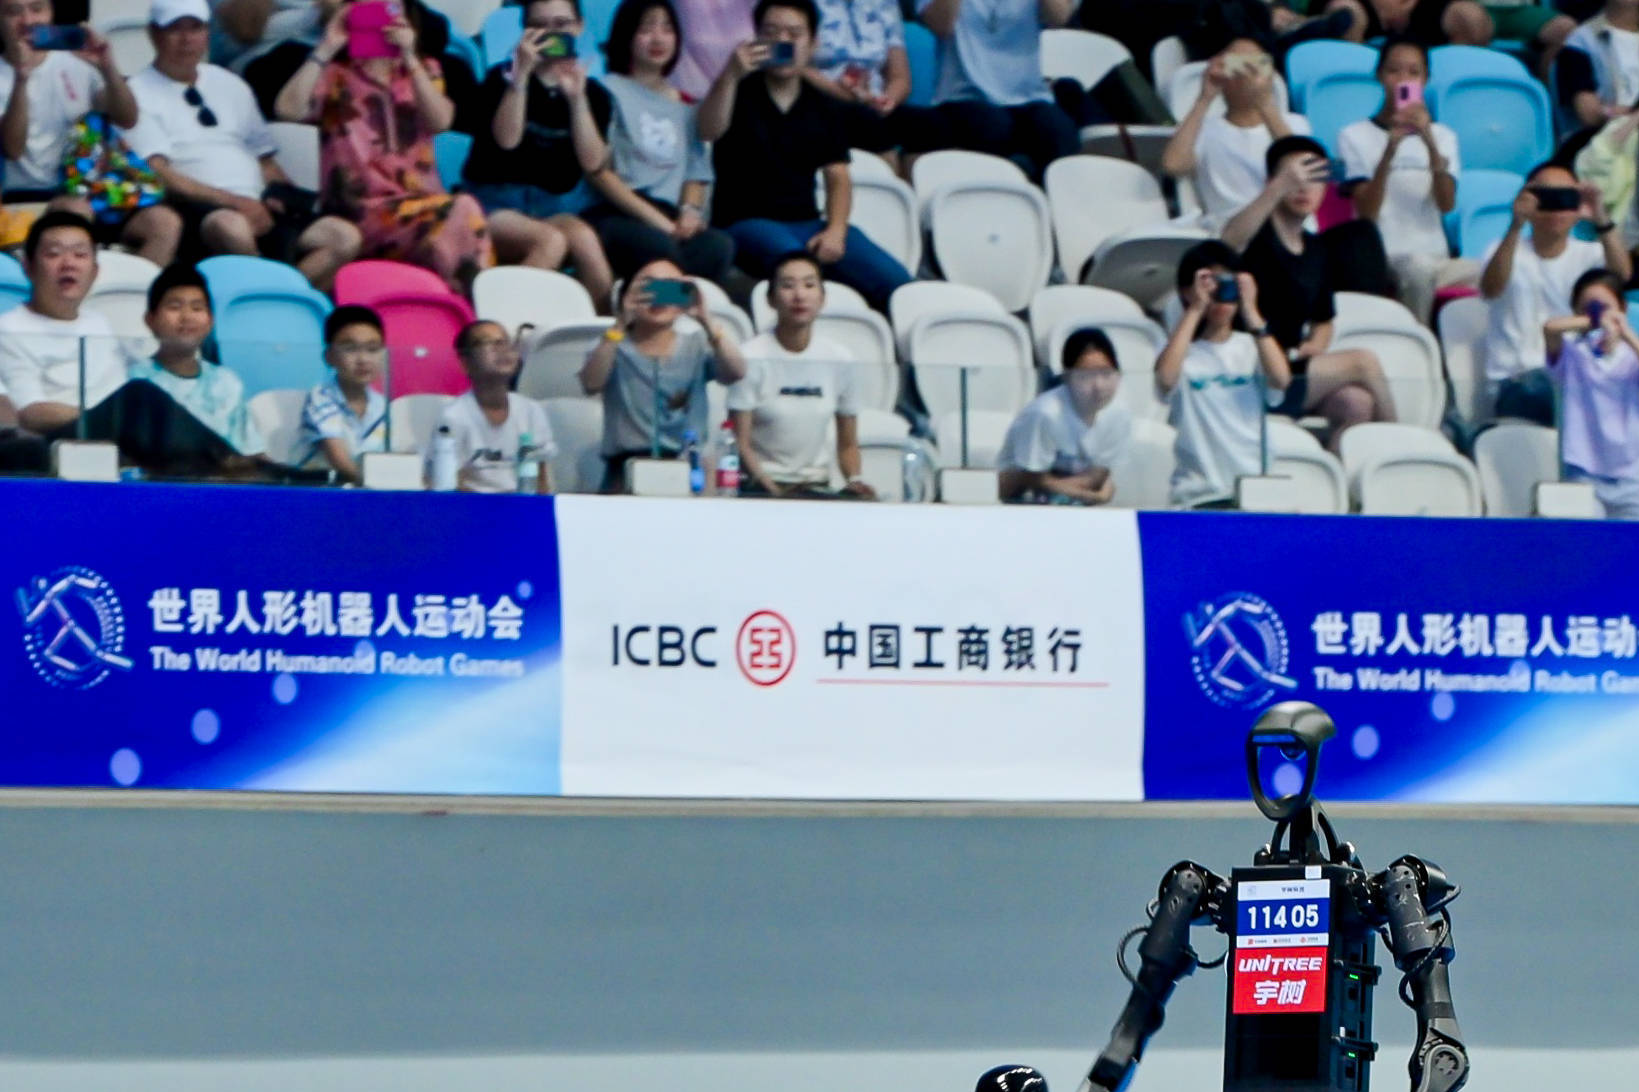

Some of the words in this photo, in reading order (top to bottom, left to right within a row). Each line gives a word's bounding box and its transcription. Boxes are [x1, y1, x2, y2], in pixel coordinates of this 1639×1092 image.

[149, 587, 524, 640] 世界人形机器人运动会
[149, 645, 191, 672] The
[195, 648, 262, 673] World
[265, 649, 376, 674] Humanoid
[380, 651, 446, 676] Robot
[449, 653, 525, 677] Games
[611, 624, 718, 668] ICBC
[823, 621, 1084, 674] 中国工商银行
[1313, 666, 1353, 691] The
[1357, 667, 1421, 692] World
[1424, 668, 1531, 693] Humanoid
[1534, 669, 1597, 693] Robot
[1247, 903, 1319, 930] 11405
[1253, 979, 1307, 1006] 宇树
